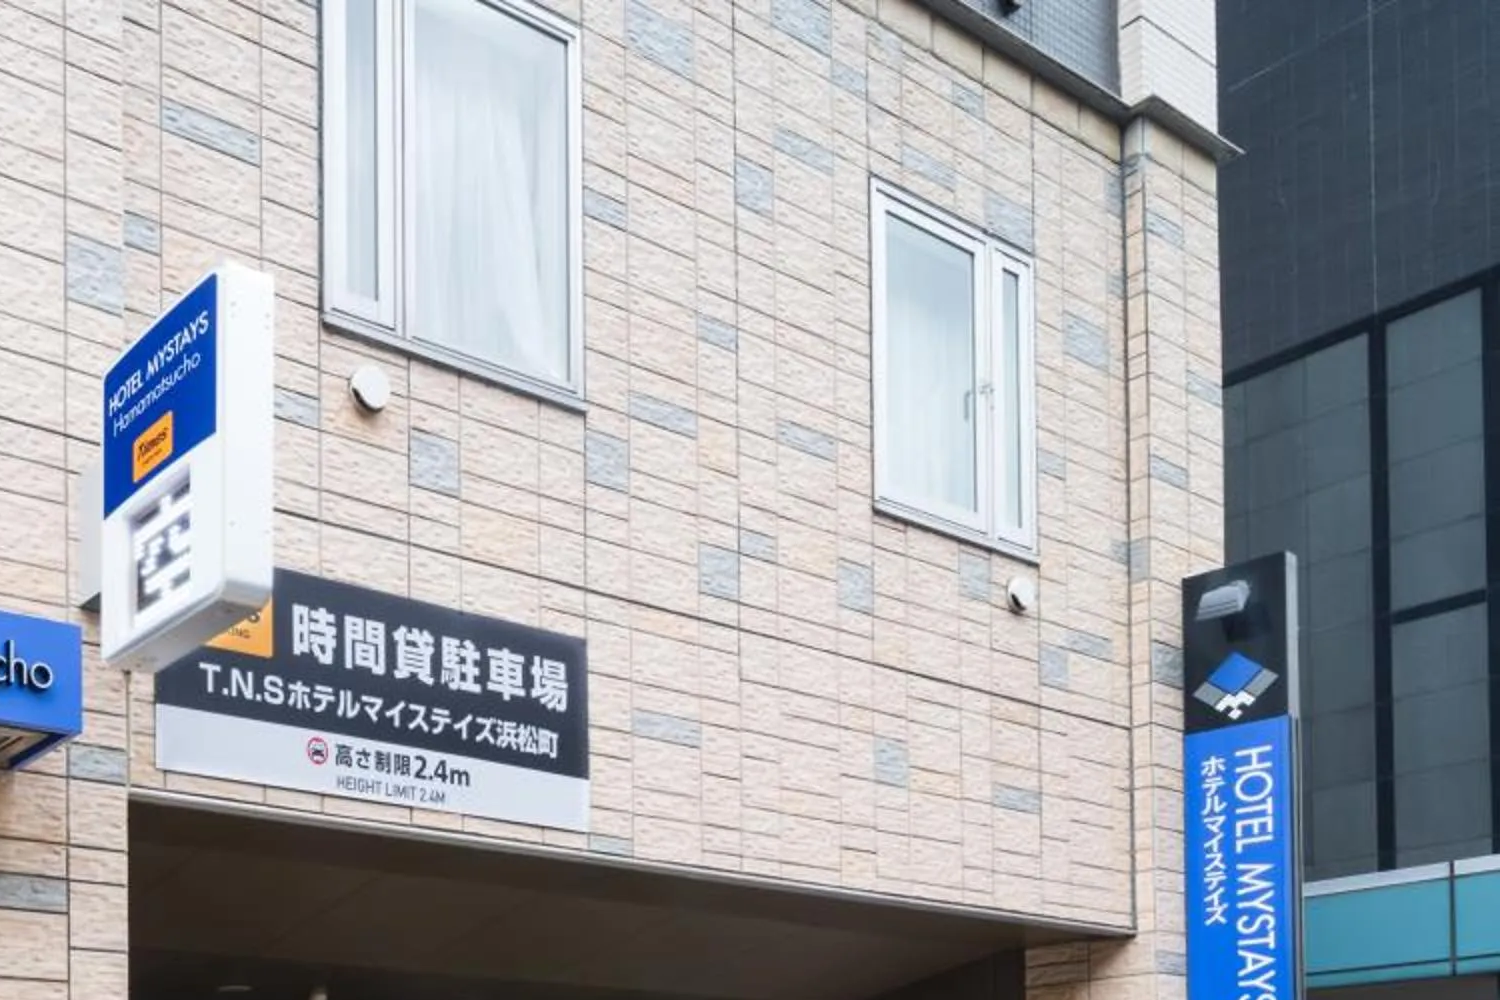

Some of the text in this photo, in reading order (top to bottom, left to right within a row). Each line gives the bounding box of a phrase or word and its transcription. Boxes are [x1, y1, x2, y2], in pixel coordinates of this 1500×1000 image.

[108, 310, 209, 417] HOTEL MYSTAYS
[113, 352, 201, 437] Hamamatsucho
[291, 603, 569, 712] 時間貸駐車場
[199, 663, 559, 759] T.N.Sホテルマイステイズ浜松町
[335, 743, 471, 787] 高さ制限2.4m
[337, 775, 382, 795] HEIGHT
[385, 782, 417, 801] LIMIT
[1234, 744, 1274, 854] HOTEL
[1201, 755, 1228, 926] ホテルマイステイズ
